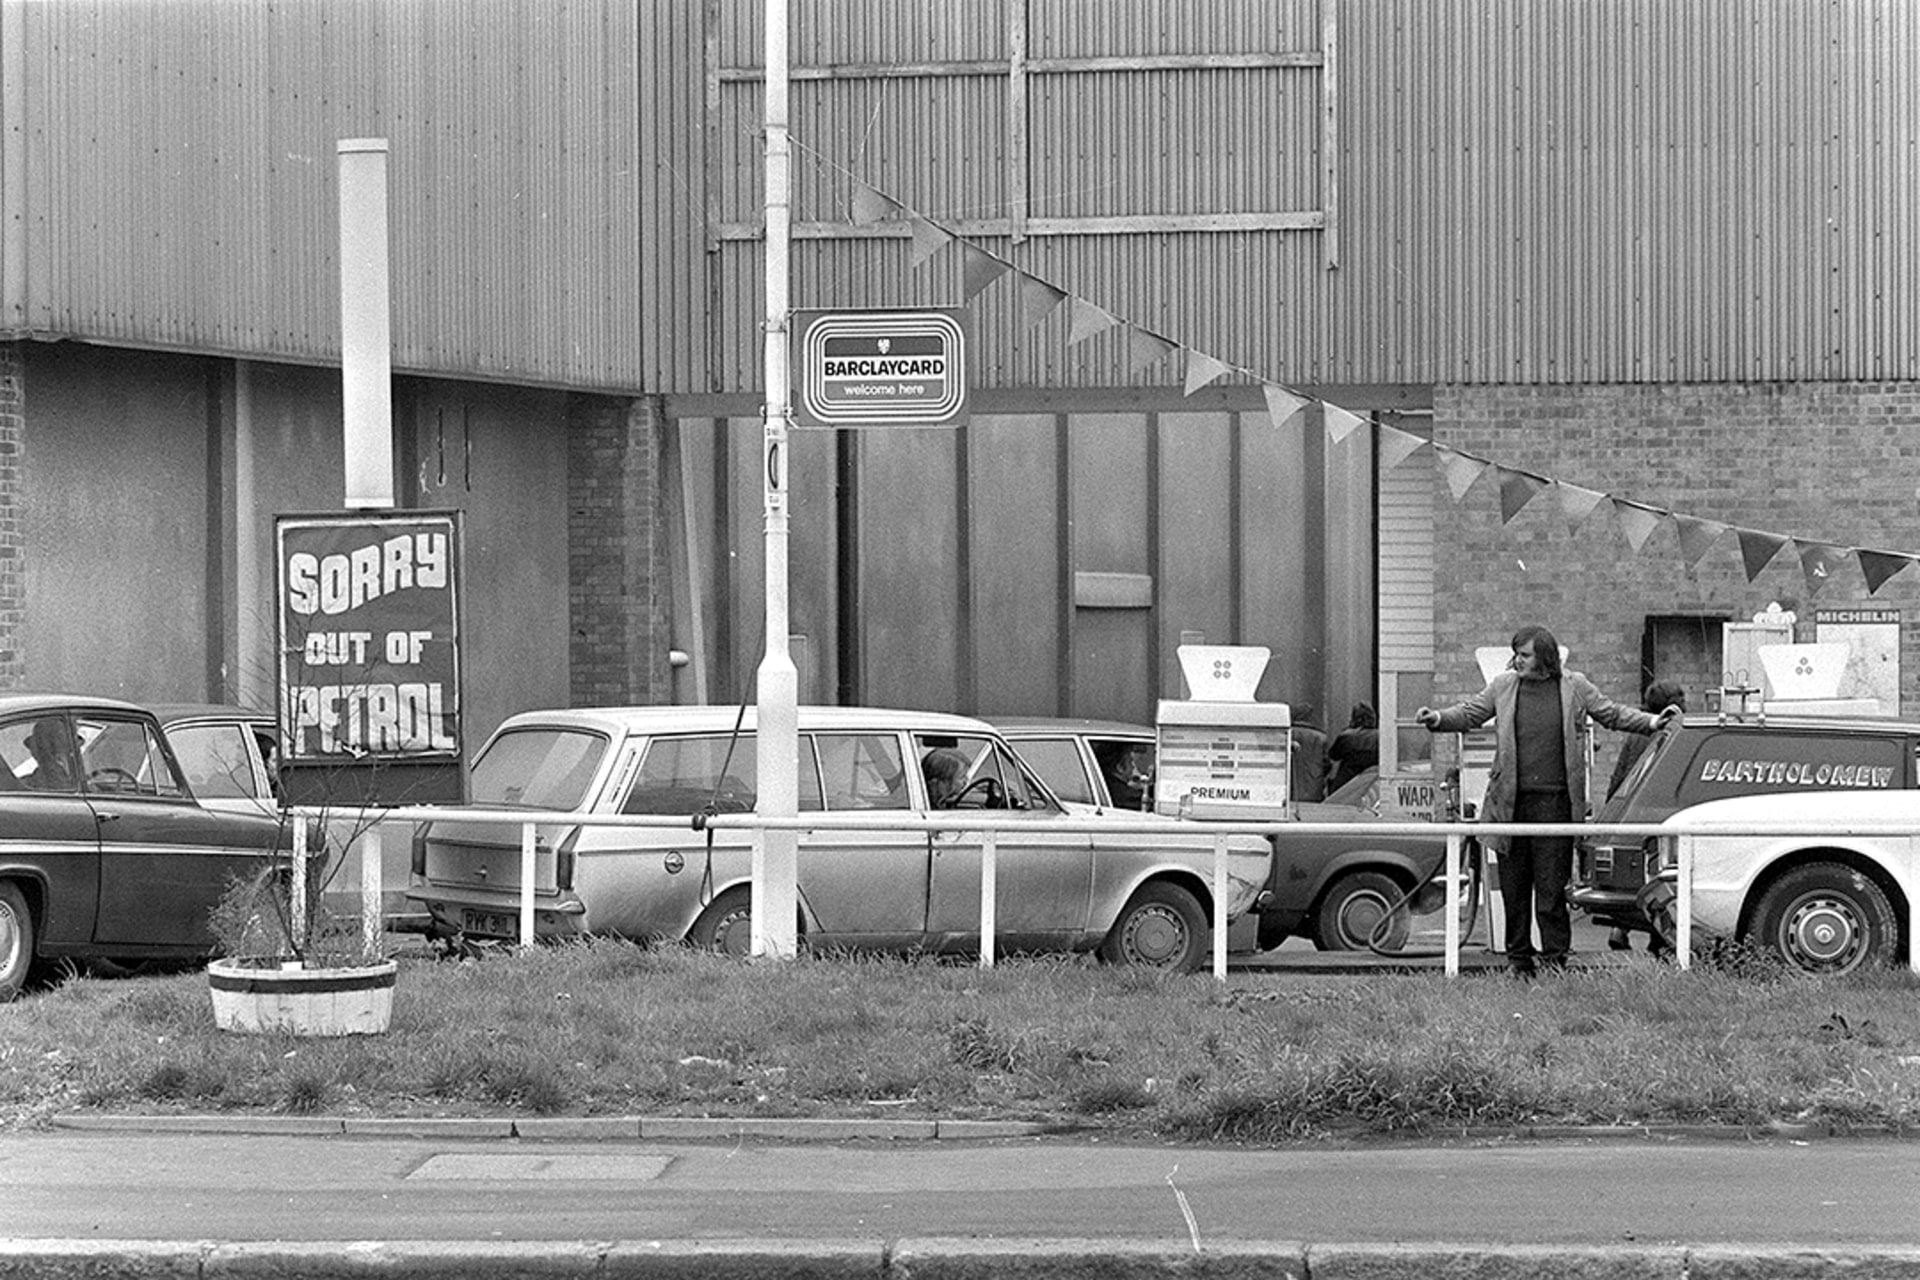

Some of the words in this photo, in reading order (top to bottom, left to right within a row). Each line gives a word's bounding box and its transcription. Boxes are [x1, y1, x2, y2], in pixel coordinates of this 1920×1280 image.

[824, 360, 944, 376] BARCLAYCARD
[844, 384, 896, 396] welcome
[899, 383, 925, 395] here
[289, 533, 447, 615] SORRY
[1816, 611, 1900, 622] MICHELIN
[304, 632, 372, 665] OUT
[385, 631, 433, 664] OF
[289, 683, 455, 753] PETROL
[1700, 759, 1894, 787] BARTHOLOMEW
[1190, 786, 1251, 800] PREMIUM
